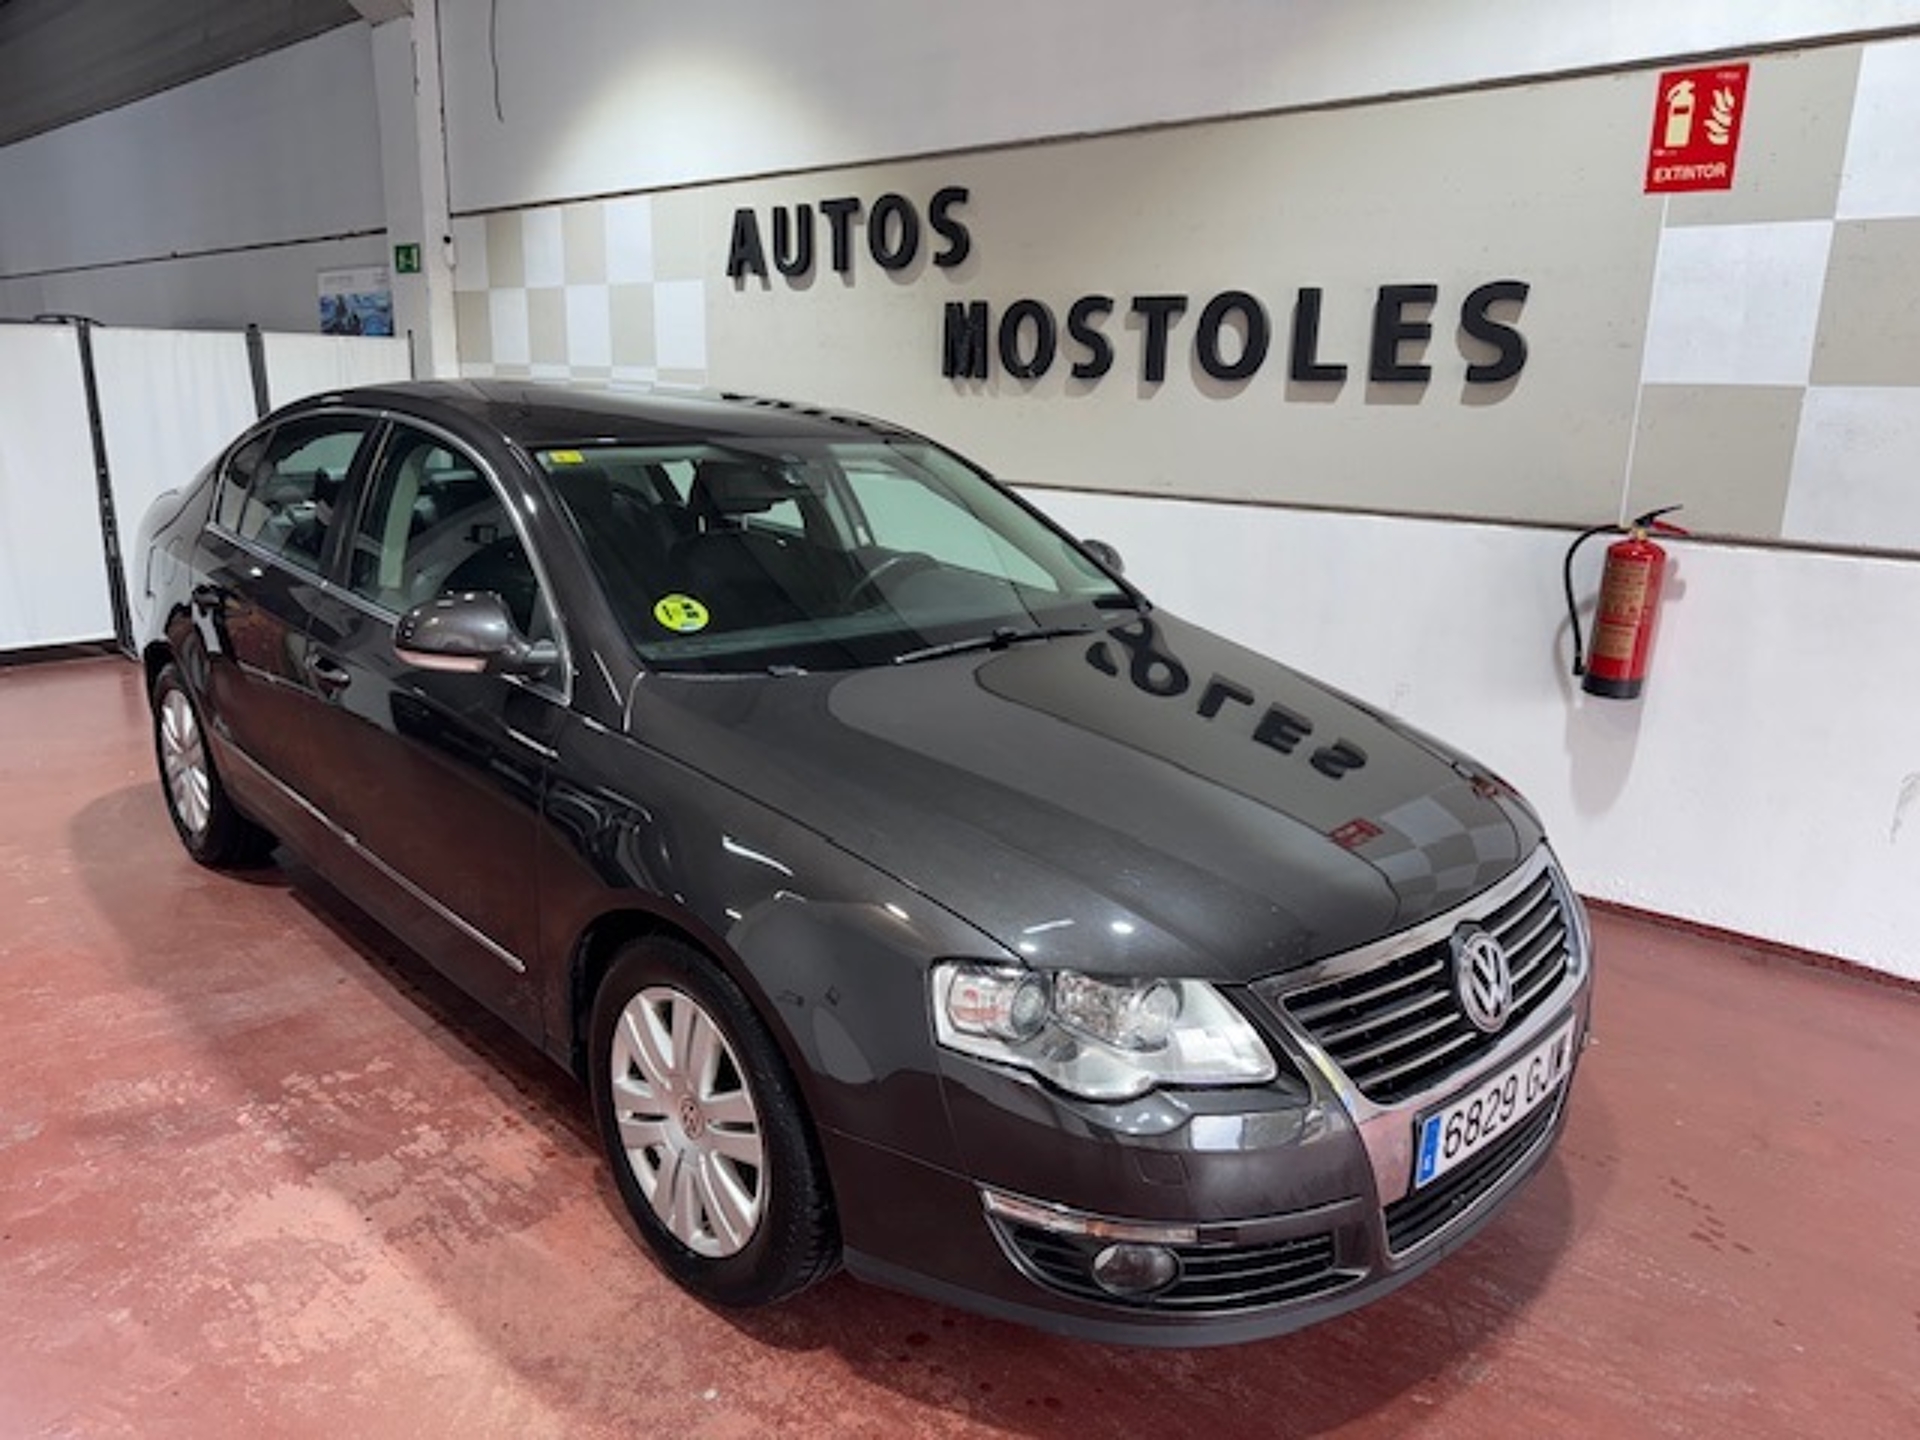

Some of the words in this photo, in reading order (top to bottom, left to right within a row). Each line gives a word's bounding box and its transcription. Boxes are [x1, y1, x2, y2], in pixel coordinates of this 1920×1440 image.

[1652, 161, 1727, 184] EXTINTOR
[726, 187, 970, 277] AUTOS
[942, 280, 1531, 384] MOSTOLES
[1442, 1074, 1519, 1160] 6829
